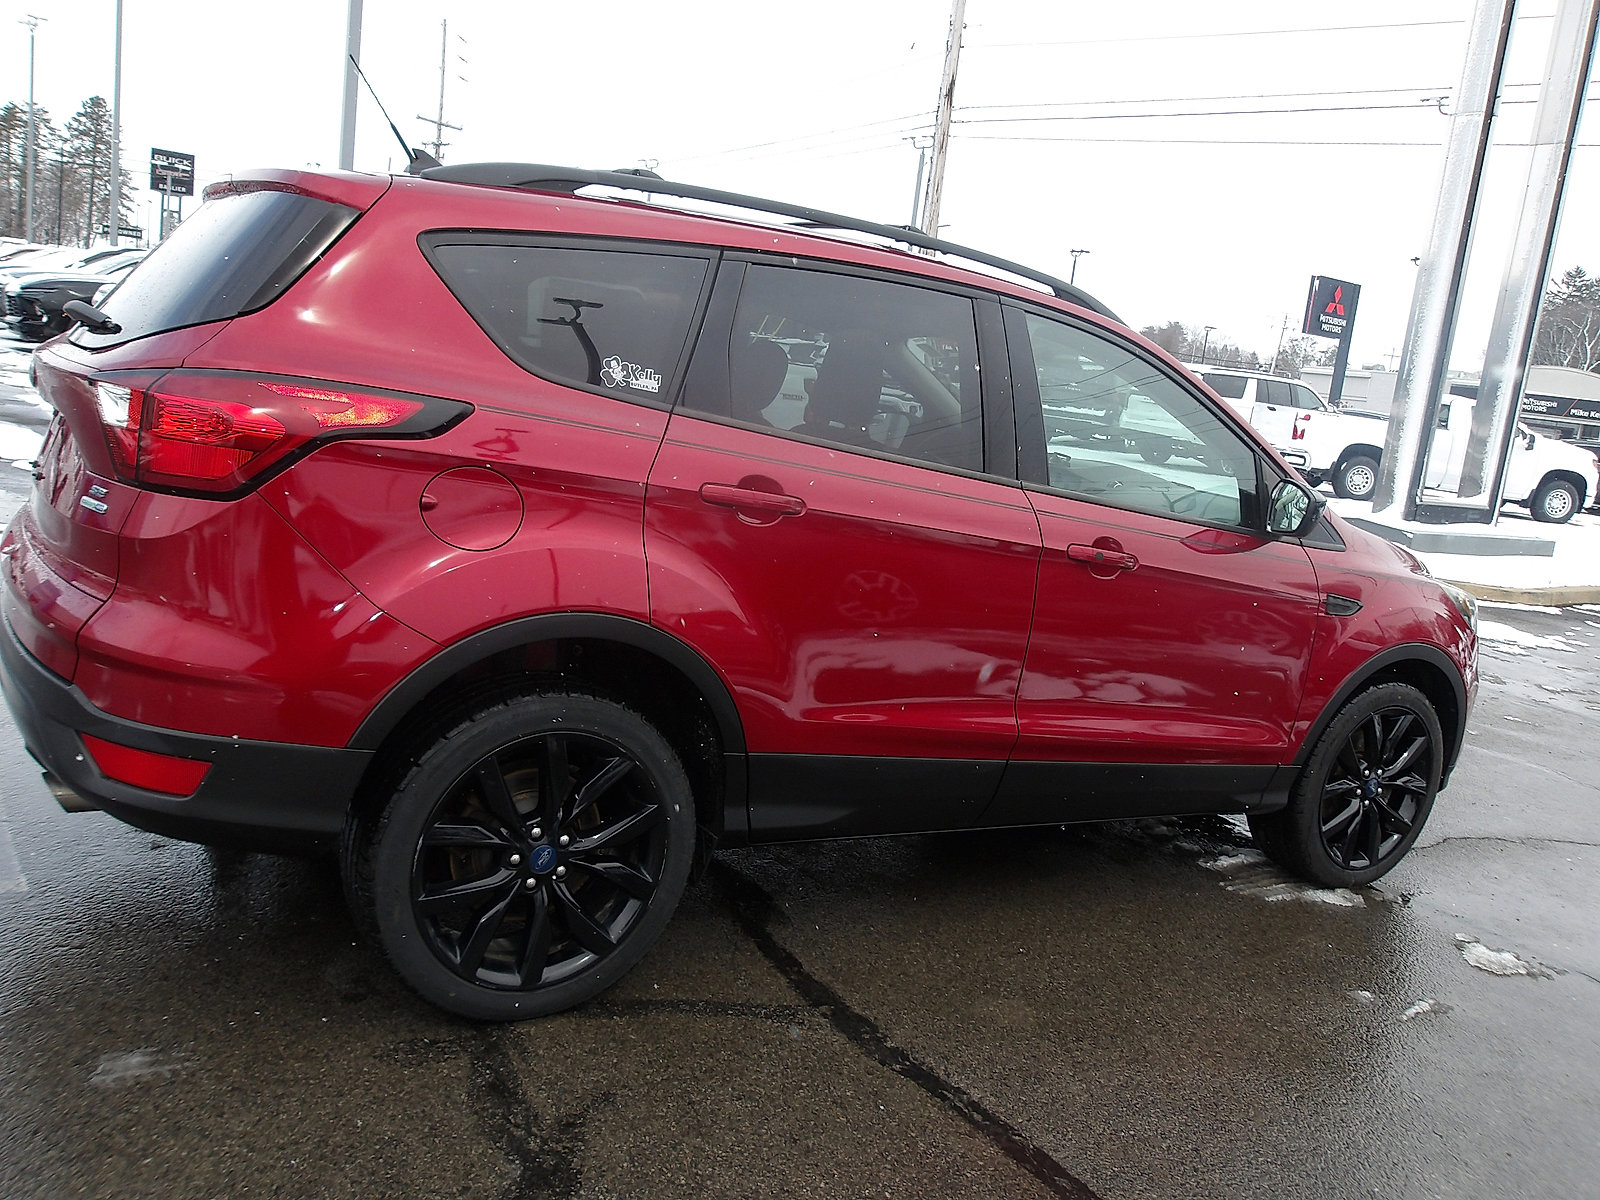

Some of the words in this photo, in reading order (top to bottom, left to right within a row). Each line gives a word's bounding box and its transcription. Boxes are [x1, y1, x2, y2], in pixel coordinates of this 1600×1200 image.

[154, 154, 192, 167] BUICK
[158, 183, 186, 192] BALIER
[1320, 313, 1347, 327] MITSUBISHI
[1321, 323, 1342, 334] MOTORS
[630, 364, 662, 387] Kelly
[1570, 408, 1590, 417] Mike
